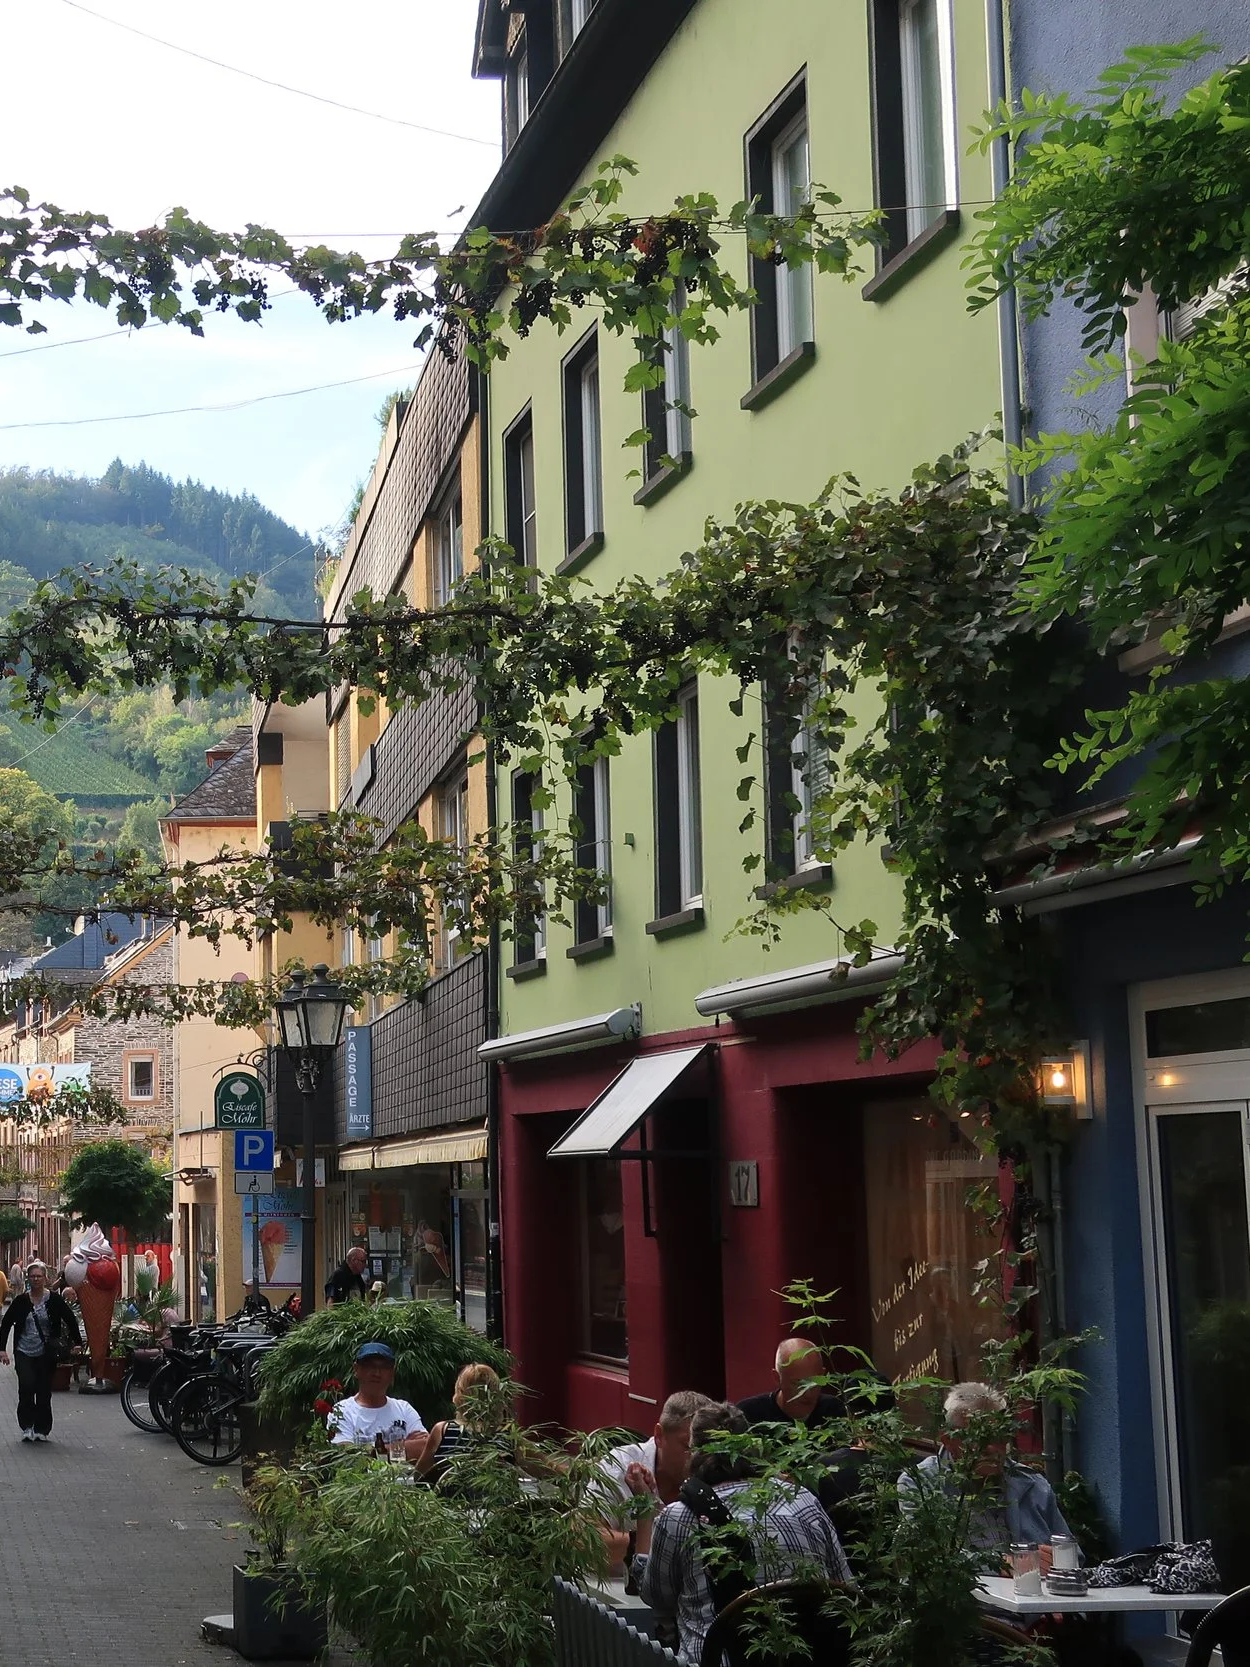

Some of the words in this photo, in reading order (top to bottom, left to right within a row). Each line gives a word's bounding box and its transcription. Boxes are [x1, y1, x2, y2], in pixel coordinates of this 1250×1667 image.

[348, 1031, 358, 1107] PASSAGE
[221, 1112, 258, 1124] Mohr
[349, 1113, 370, 1124] ÄRZTE
[243, 1136, 265, 1166] P
[735, 1165, 750, 1201] 17
[871, 1298, 892, 1324] Von
[892, 1279, 906, 1305] der
[893, 1327, 907, 1353] bis
[907, 1312, 924, 1338] zur
